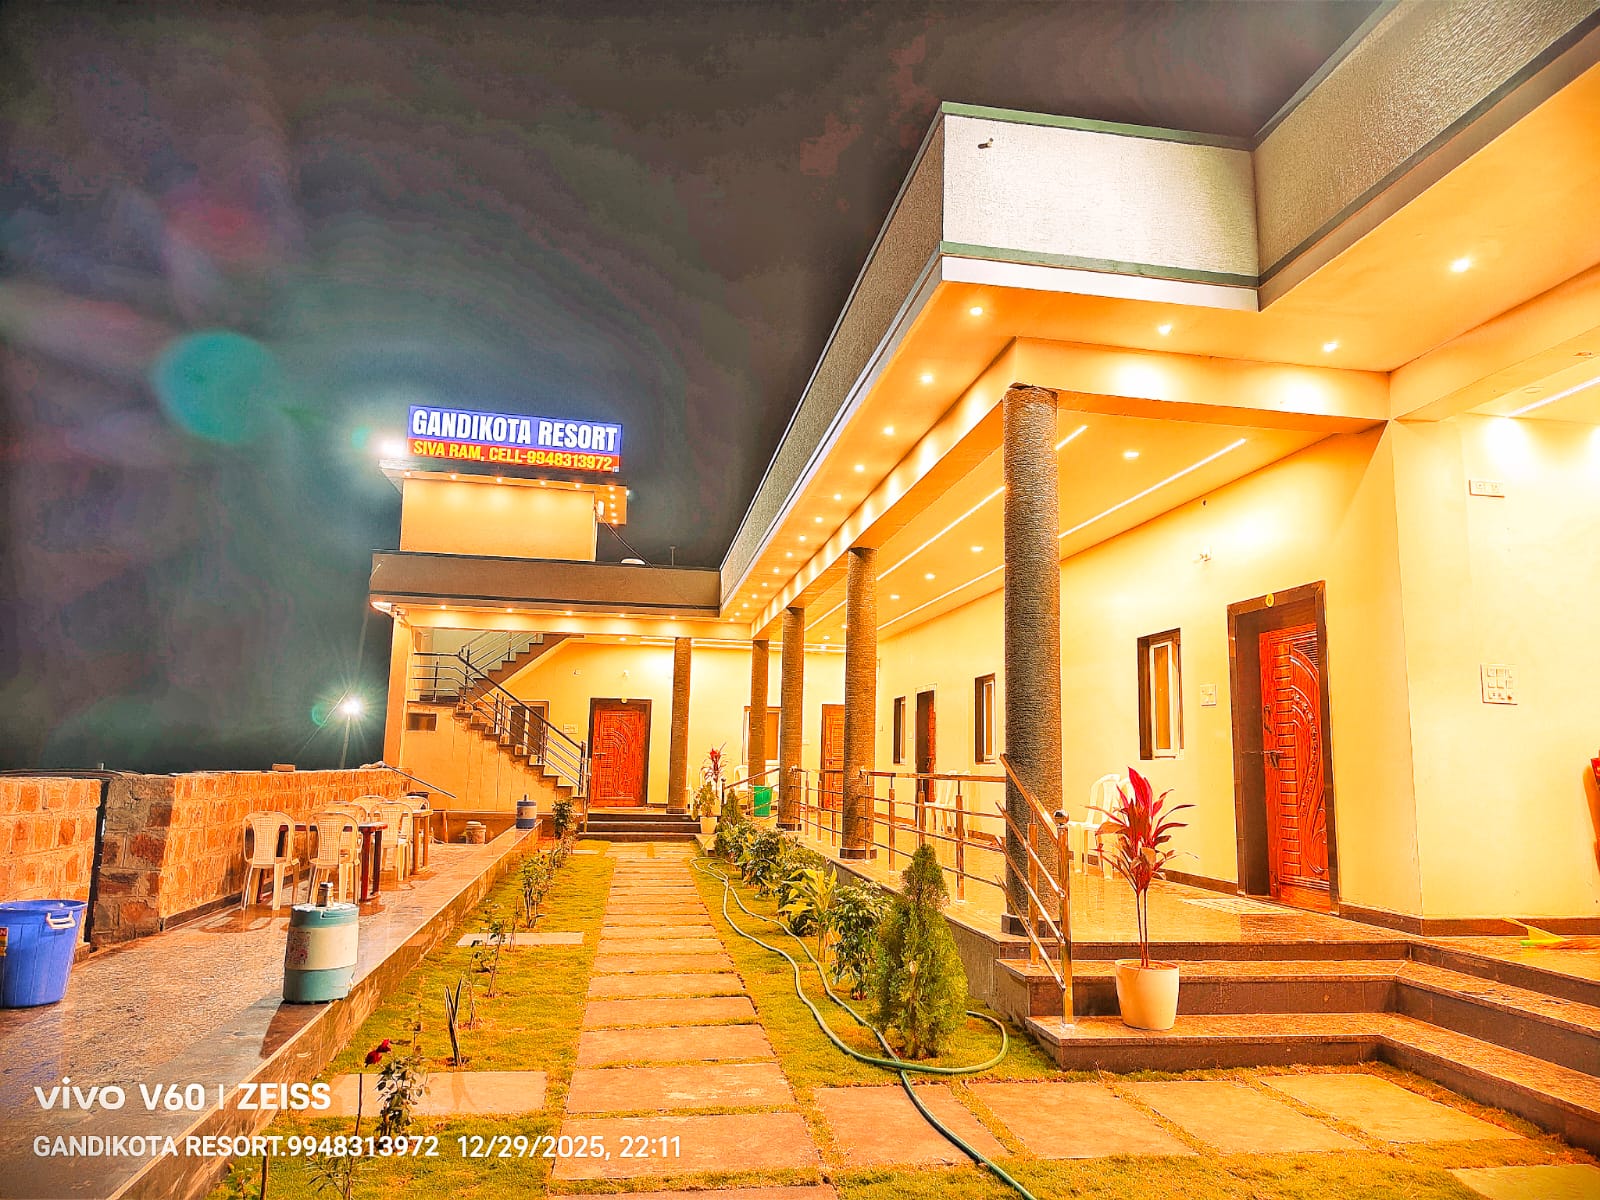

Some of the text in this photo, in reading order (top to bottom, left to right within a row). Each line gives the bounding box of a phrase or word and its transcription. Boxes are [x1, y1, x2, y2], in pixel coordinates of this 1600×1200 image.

[412, 409, 618, 452] GANDIKOTA RESORT
[413, 440, 613, 470] SIVA RAM, CELL-9948313972
